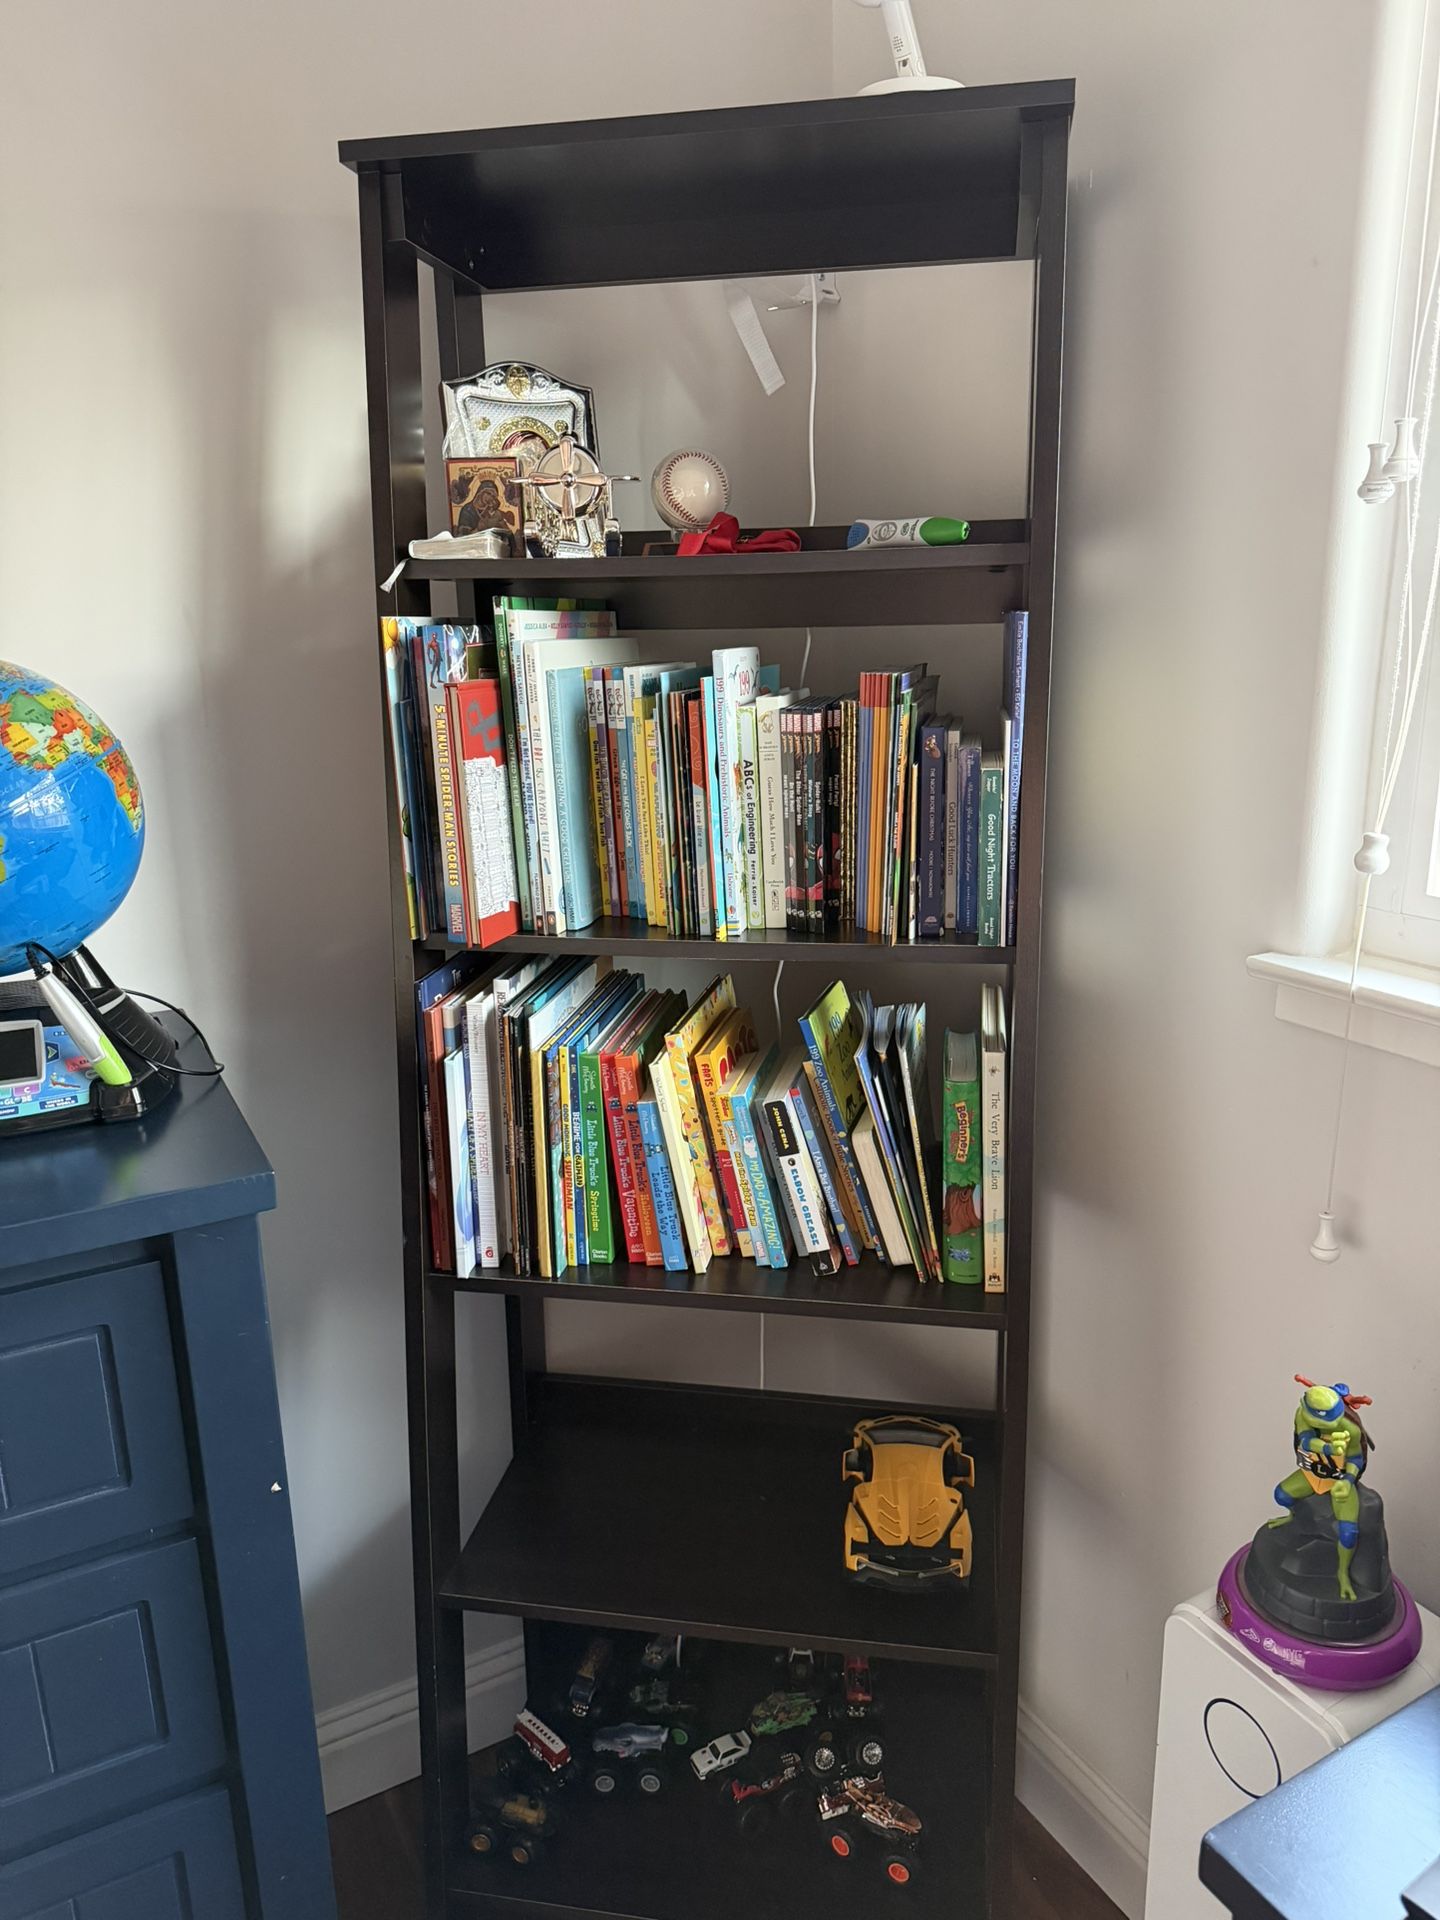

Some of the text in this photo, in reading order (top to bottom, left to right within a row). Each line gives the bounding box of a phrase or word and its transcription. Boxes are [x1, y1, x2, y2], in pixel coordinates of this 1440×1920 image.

[508, 734, 516, 756] DON'T
[522, 737, 530, 747] I'm
[533, 727, 542, 743] THE
[593, 740, 601, 752] One
[1012, 738, 1019, 748] TO
[510, 757, 518, 774] FEED
[534, 747, 544, 762] DAY
[594, 753, 602, 765] fish
[612, 748, 620, 769] Green
[715, 676, 732, 838] 199 Dinosaurs and Prehistoric Animals
[1011, 750, 1019, 766] THE
[511, 775, 519, 789] THE
[555, 763, 566, 806] BECOMING
[595, 768, 603, 780] two
[613, 771, 621, 787] Eggs
[620, 768, 628, 780] CAT
[1011, 768, 1019, 793] MOON
[435, 704, 460, 887] 5-MINUTE SPIDER-MAN STORIES
[513, 791, 521, 808] BEAR
[525, 782, 534, 803] YOU'RE
[537, 782, 548, 826] CRAYONS
[596, 796, 604, 806] red
[622, 795, 630, 808] HAT
[1010, 795, 1018, 812] AND
[527, 803, 536, 825] Scared!
[597, 807, 605, 818] fish
[743, 759, 758, 855] ABCs of Engineering
[948, 801, 956, 823] Good
[559, 818, 569, 842] GOOD
[598, 822, 606, 834] blue
[623, 809, 632, 830] COMES
[540, 830, 550, 854] QUIT
[599, 835, 607, 847] fish
[624, 831, 633, 848] BACK
[1009, 837, 1017, 852] FOR
[562, 846, 572, 884] CREATURE
[947, 845, 955, 876] Hunters
[986, 814, 996, 900] Good Night Tractors
[727, 872, 735, 899] Usborne
[450, 903, 463, 934] MARVEL
[701, 1063, 713, 1087] FARTS
[808, 1044, 838, 1112] 199 Zoo Animals
[562, 1103, 570, 1122] GOOD
[708, 1097, 723, 1127] spotter's
[572, 1111, 582, 1141] BEDTIME
[612, 1115, 625, 1138] Little
[715, 1128, 726, 1146] guide
[772, 1107, 790, 1149] JOHN CENA
[956, 1105, 969, 1159] Beginner's
[476, 1111, 490, 1175] IN MY HEART
[616, 1138, 626, 1156] Blue
[988, 1091, 1000, 1190] The Very Brave Lion
[574, 1155, 584, 1185] BATMAN
[618, 1158, 632, 1188] Truck's
[750, 1160, 760, 1172] MY
[813, 1155, 823, 1168] Am
[564, 1159, 574, 1210] SUPERMAN
[586, 1119, 601, 1232] Little Blue Truck's Springtime
[628, 1119, 654, 1236] Little Blue Truck's Halloween
[750, 1172, 764, 1191] DAD
[817, 1173, 828, 1184] Big
[840, 1164, 856, 1193] Stories
[734, 1151, 758, 1227] Meet the Spidey Team
[824, 1185, 840, 1213] Brother!
[622, 1190, 639, 1238] Valentine
[652, 1172, 669, 1235] Leads the Way
[660, 1165, 680, 1240] Little Blue Truck
[790, 1168, 820, 1246] ELBOW GREASE
[756, 1198, 780, 1249] AMAZING!
